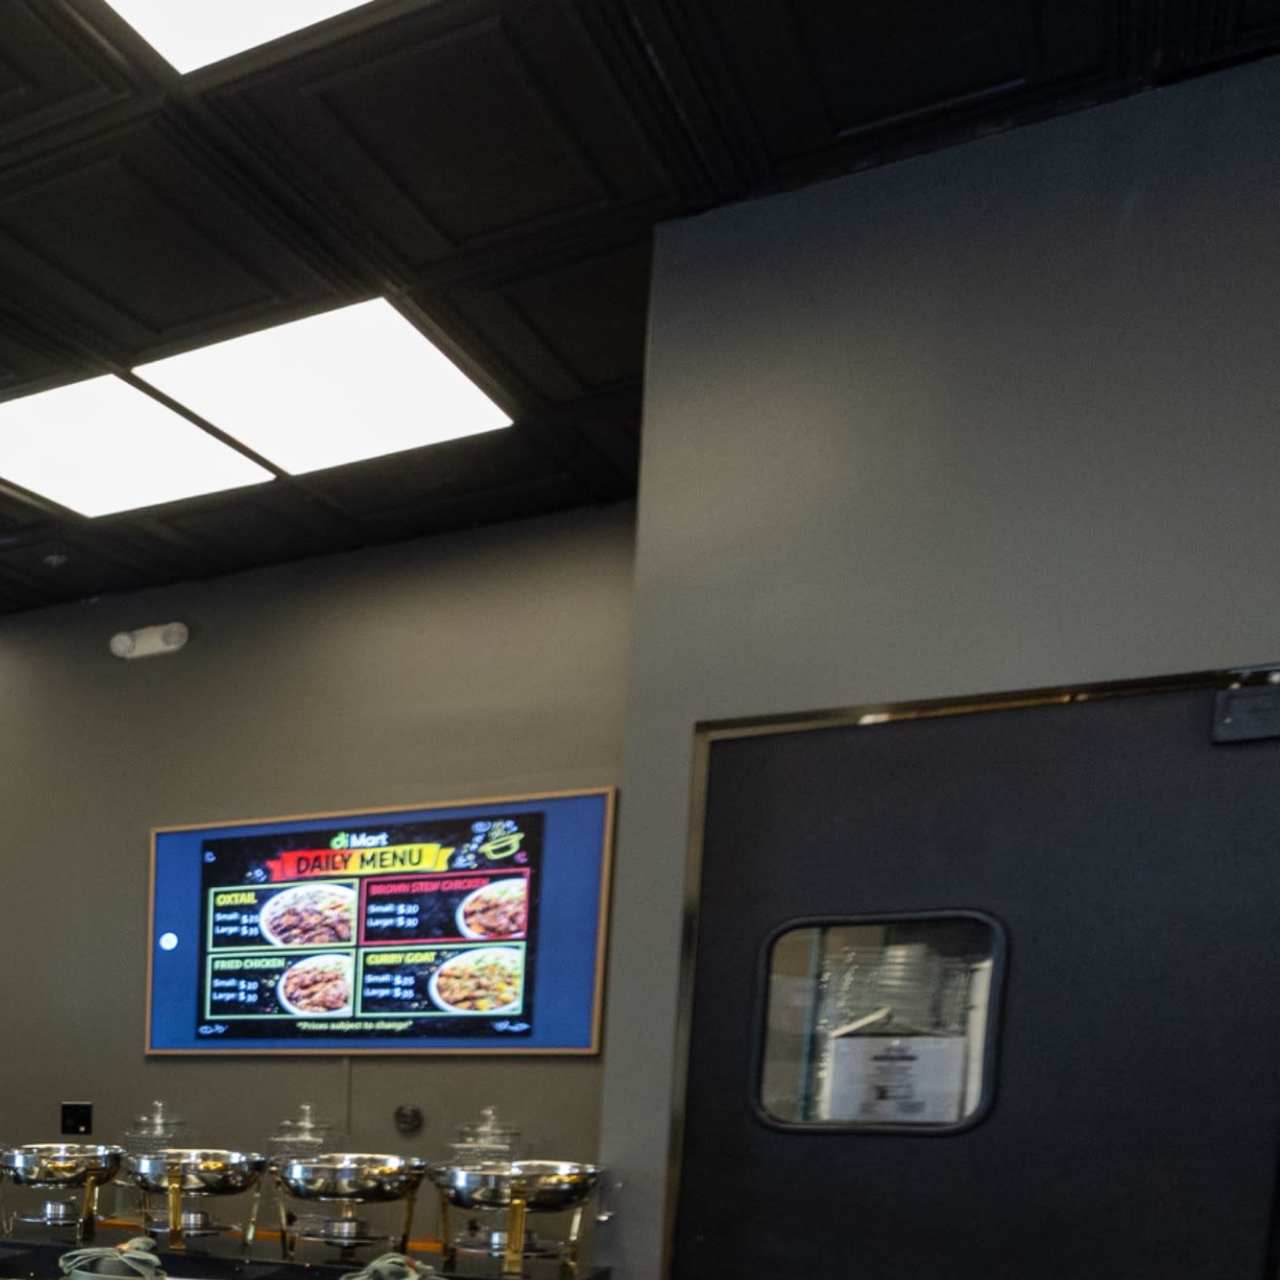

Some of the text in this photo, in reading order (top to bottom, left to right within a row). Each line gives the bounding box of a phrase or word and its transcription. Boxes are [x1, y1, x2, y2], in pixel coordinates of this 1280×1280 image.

[296, 848, 423, 874] DAILY MENU
[216, 891, 258, 907] OXTAIL
[243, 957, 285, 970] CHICKEN
[404, 951, 435, 964] GOAT
